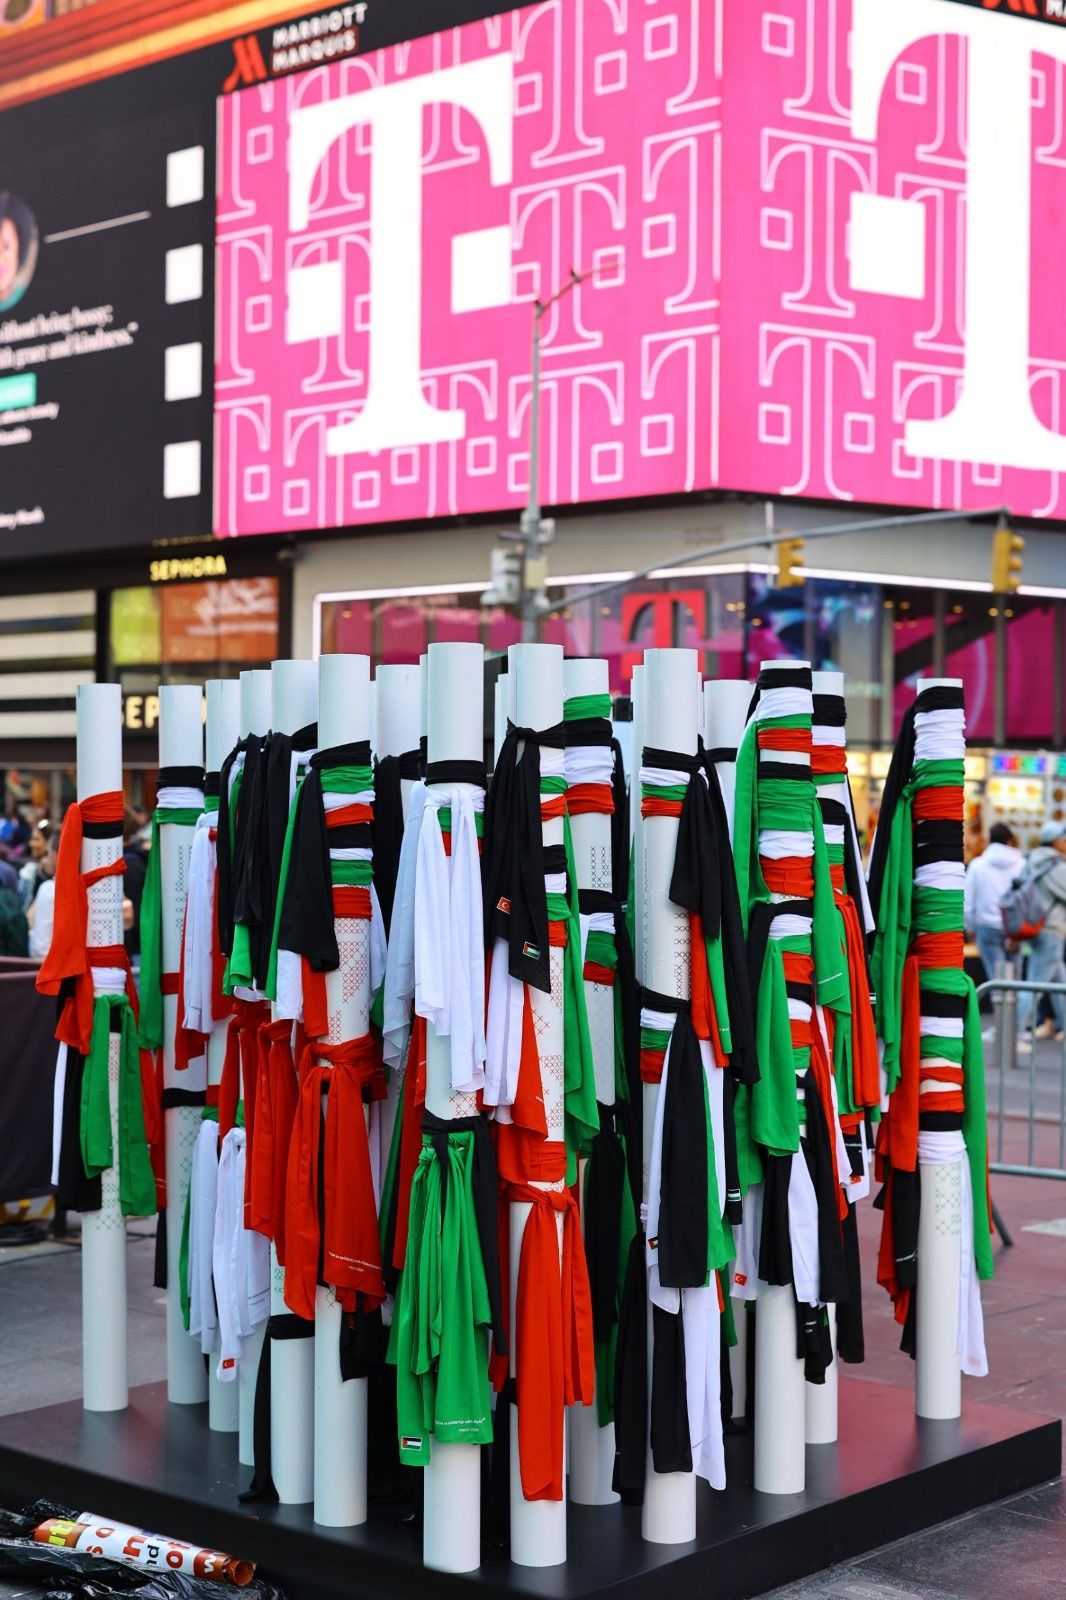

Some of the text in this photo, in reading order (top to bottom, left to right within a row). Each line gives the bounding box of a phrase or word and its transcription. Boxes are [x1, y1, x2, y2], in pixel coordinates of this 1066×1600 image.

[272, 2, 368, 49] MARRIOTT
[271, 29, 355, 72] MARQUIS
[287, 52, 513, 457] T
[150, 554, 227, 582] SEPHORA
